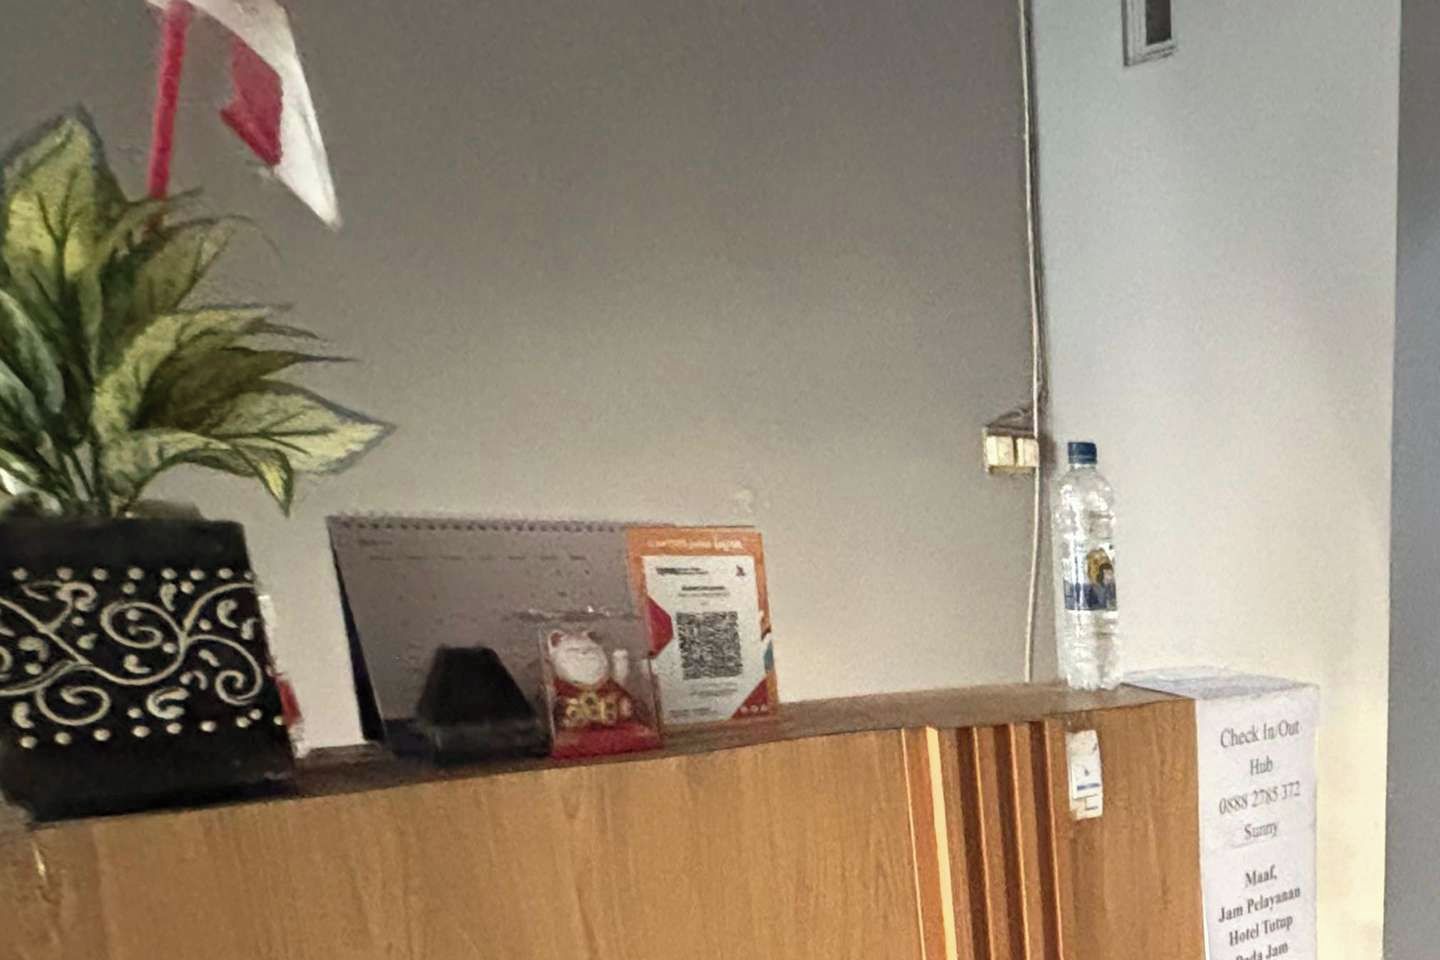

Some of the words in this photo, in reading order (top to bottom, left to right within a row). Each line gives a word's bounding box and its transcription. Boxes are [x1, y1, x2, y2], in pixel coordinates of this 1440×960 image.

[1220, 724, 1259, 748] Check
[1263, 722, 1275, 741] In
[1278, 719, 1299, 738] Out
[1249, 755, 1273, 776] Hub
[1243, 822, 1278, 840] Sunny
[1245, 864, 1277, 888] Maaf,
[1218, 905, 1243, 922] Jam
[1247, 887, 1301, 913] Pelayanan
[1229, 923, 1259, 946] Hotel
[1262, 915, 1293, 934] Tutup
[1265, 942, 1288, 959] Jam
